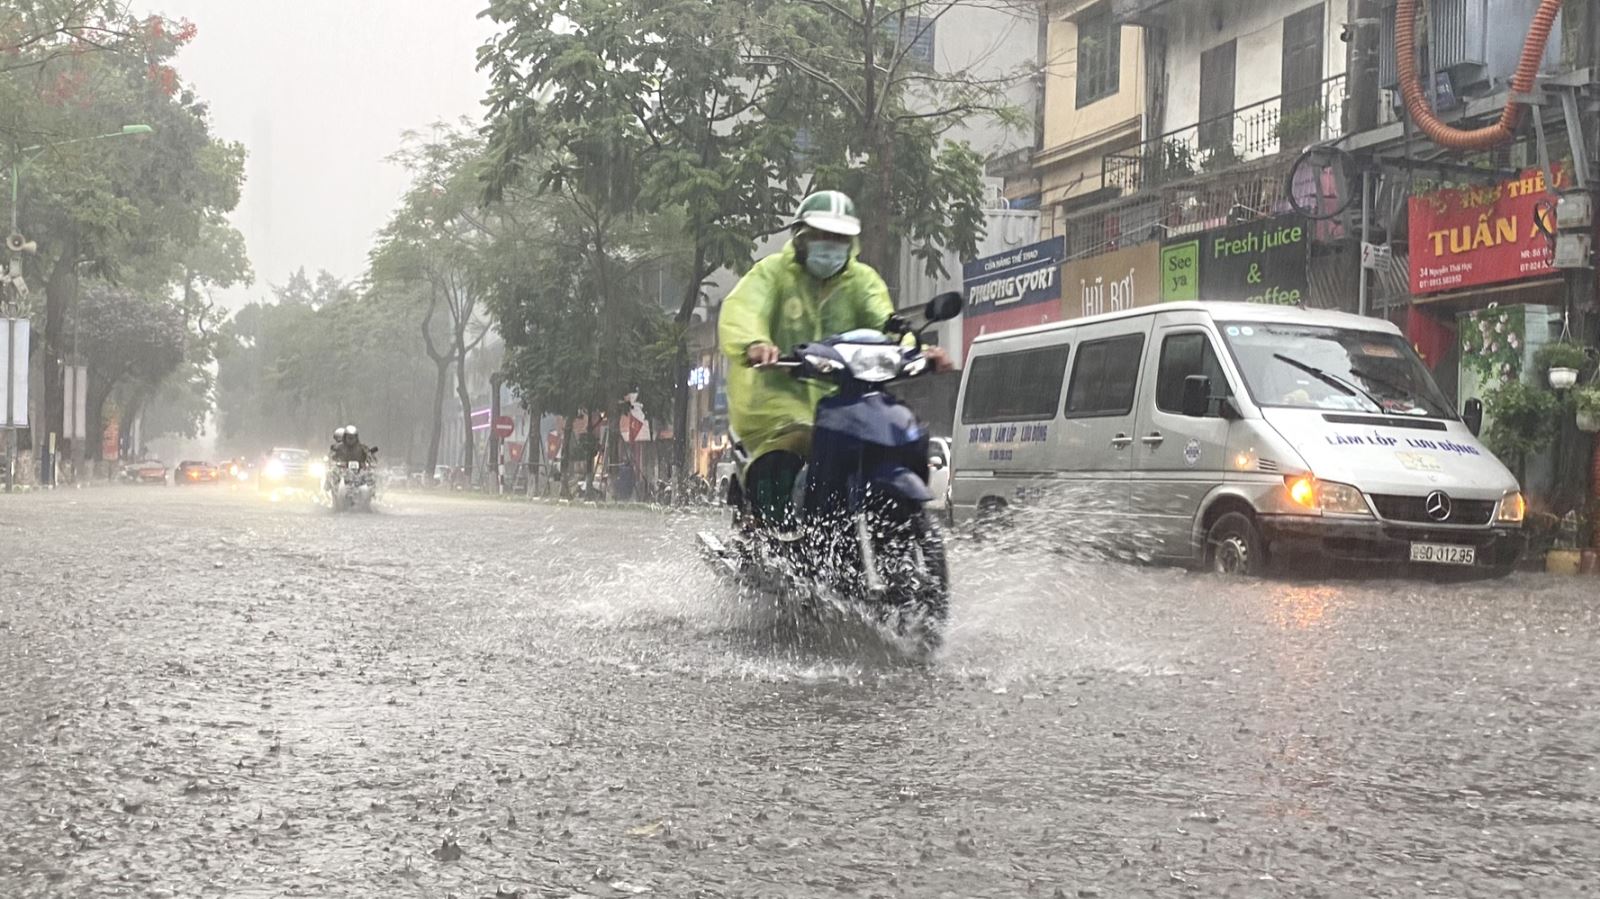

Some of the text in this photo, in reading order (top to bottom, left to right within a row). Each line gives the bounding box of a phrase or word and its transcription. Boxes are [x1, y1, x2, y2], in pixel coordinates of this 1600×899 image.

[1214, 226, 1302, 259] Fresh juice
[1428, 208, 1518, 257] TUẤN
[1168, 256, 1192, 272] See
[1247, 262, 1262, 284] &
[1171, 275, 1188, 292] ya
[1325, 430, 1481, 456] LÀM LỐP LƯU ĐỘNG
